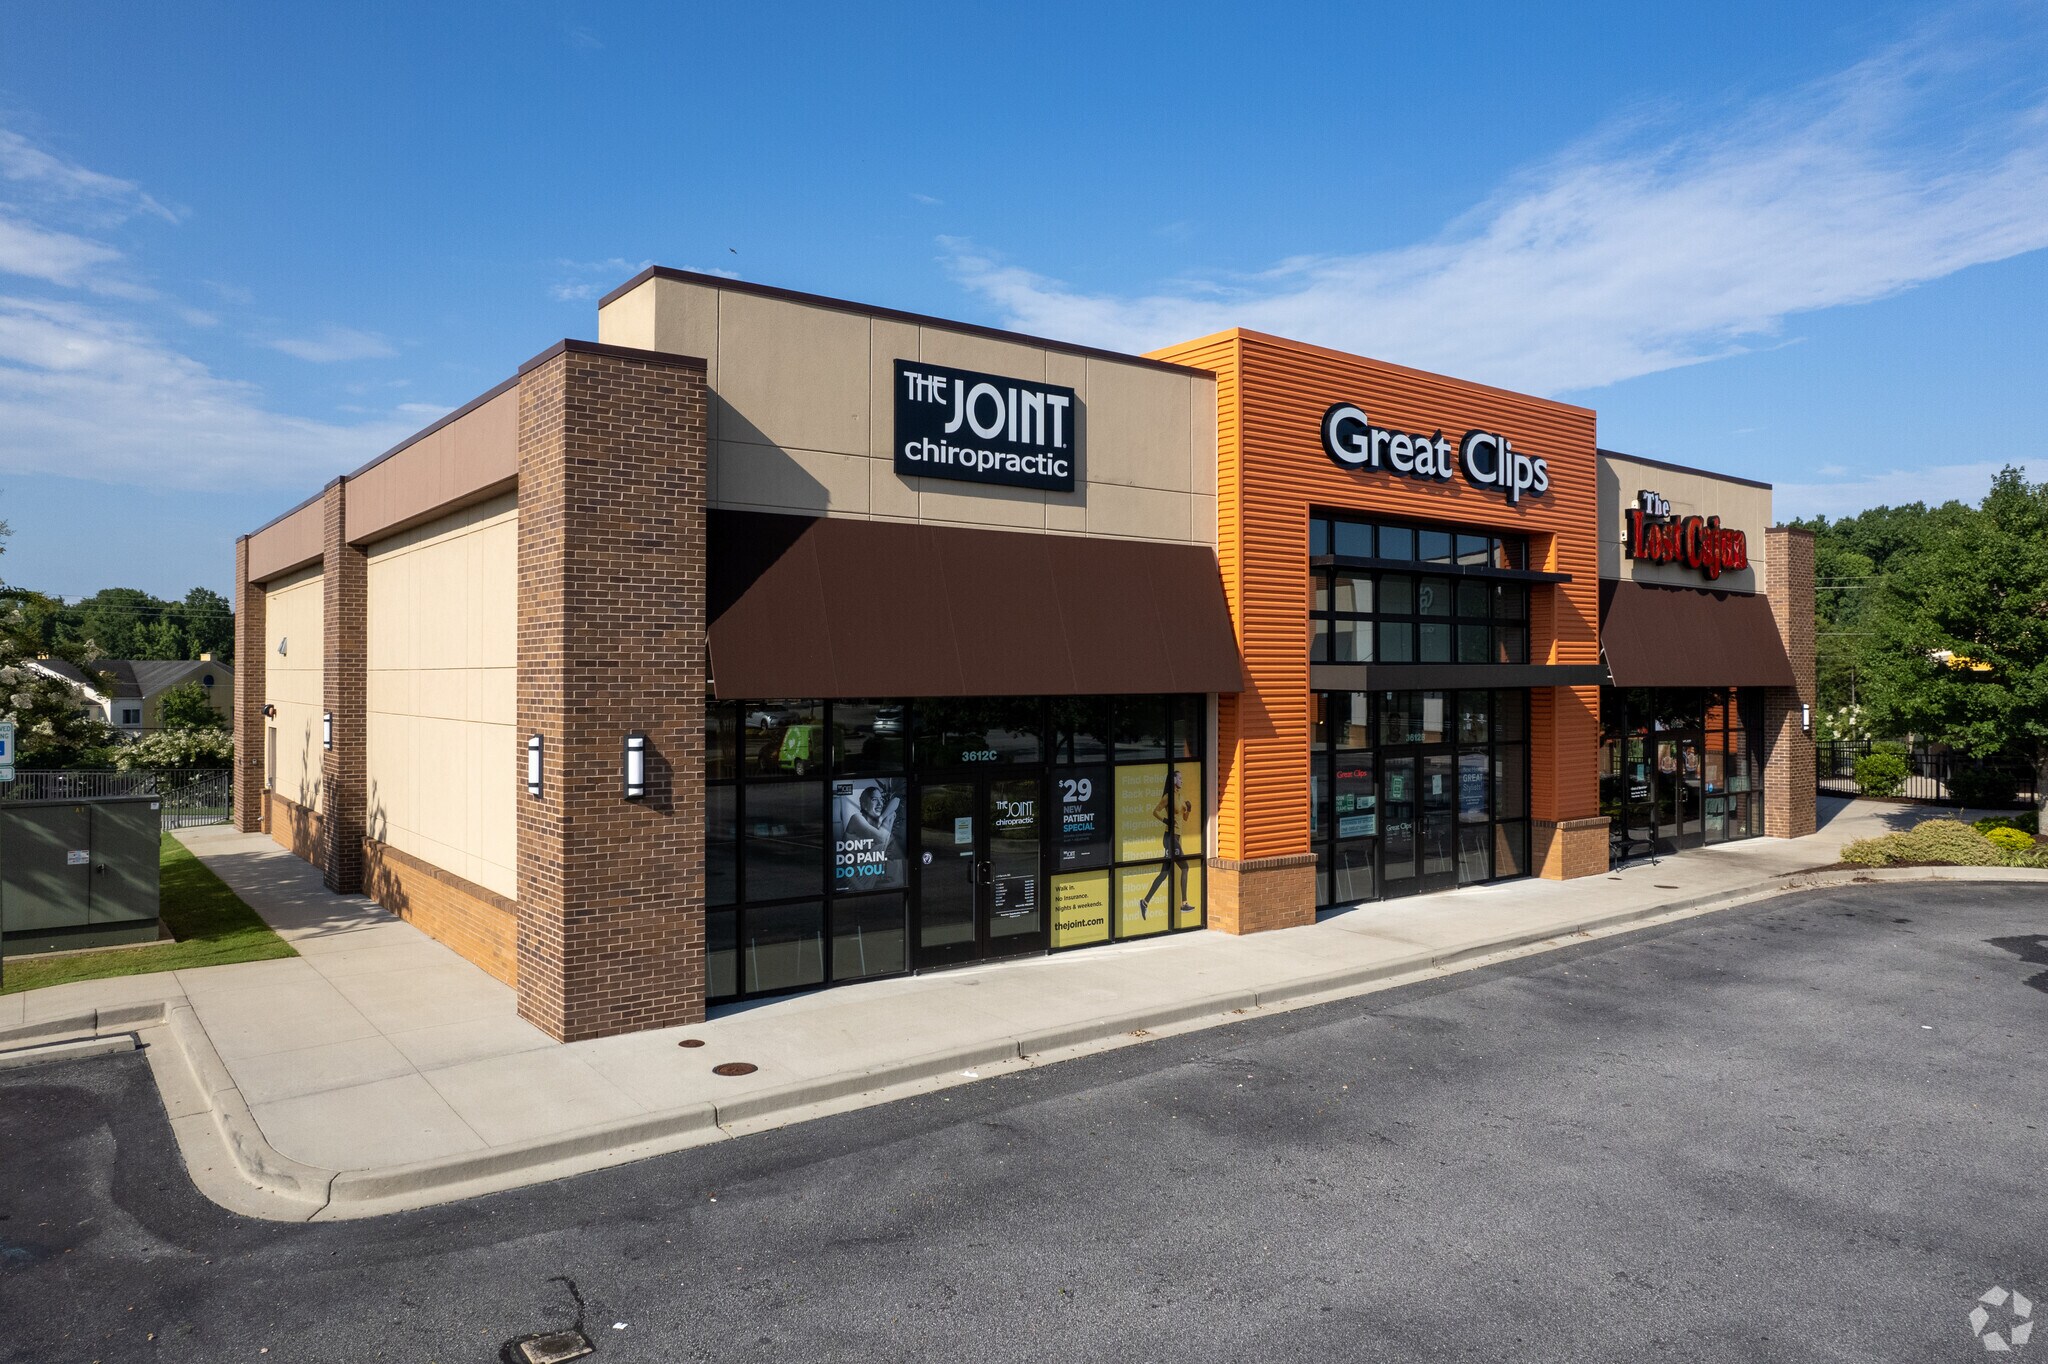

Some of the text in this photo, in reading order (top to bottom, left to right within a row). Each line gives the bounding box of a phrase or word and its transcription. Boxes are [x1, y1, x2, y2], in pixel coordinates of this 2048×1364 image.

[903, 371, 1069, 448] THE JOINT
[904, 437, 1068, 477] chiropractic
[1328, 406, 1549, 502] Great Clips
[1642, 490, 1671, 517] The
[1632, 510, 1748, 580] Lost Cajun
[962, 750, 997, 762] 3612C
[1353, 769, 1368, 778] Clips
[1463, 774, 1483, 783] GREAT
[1058, 778, 1092, 803] $29
[1063, 805, 1083, 814] NEW
[995, 816, 1034, 826] chiropractic
[1063, 813, 1095, 823] PATIENT
[1063, 823, 1095, 833] SPECIAL
[836, 839, 874, 852] DON'T
[836, 851, 888, 865] DO PAIN.
[836, 864, 885, 879] DO YOU.
[1055, 904, 1072, 912] Nights
[1054, 917, 1104, 931] thejoint.com
